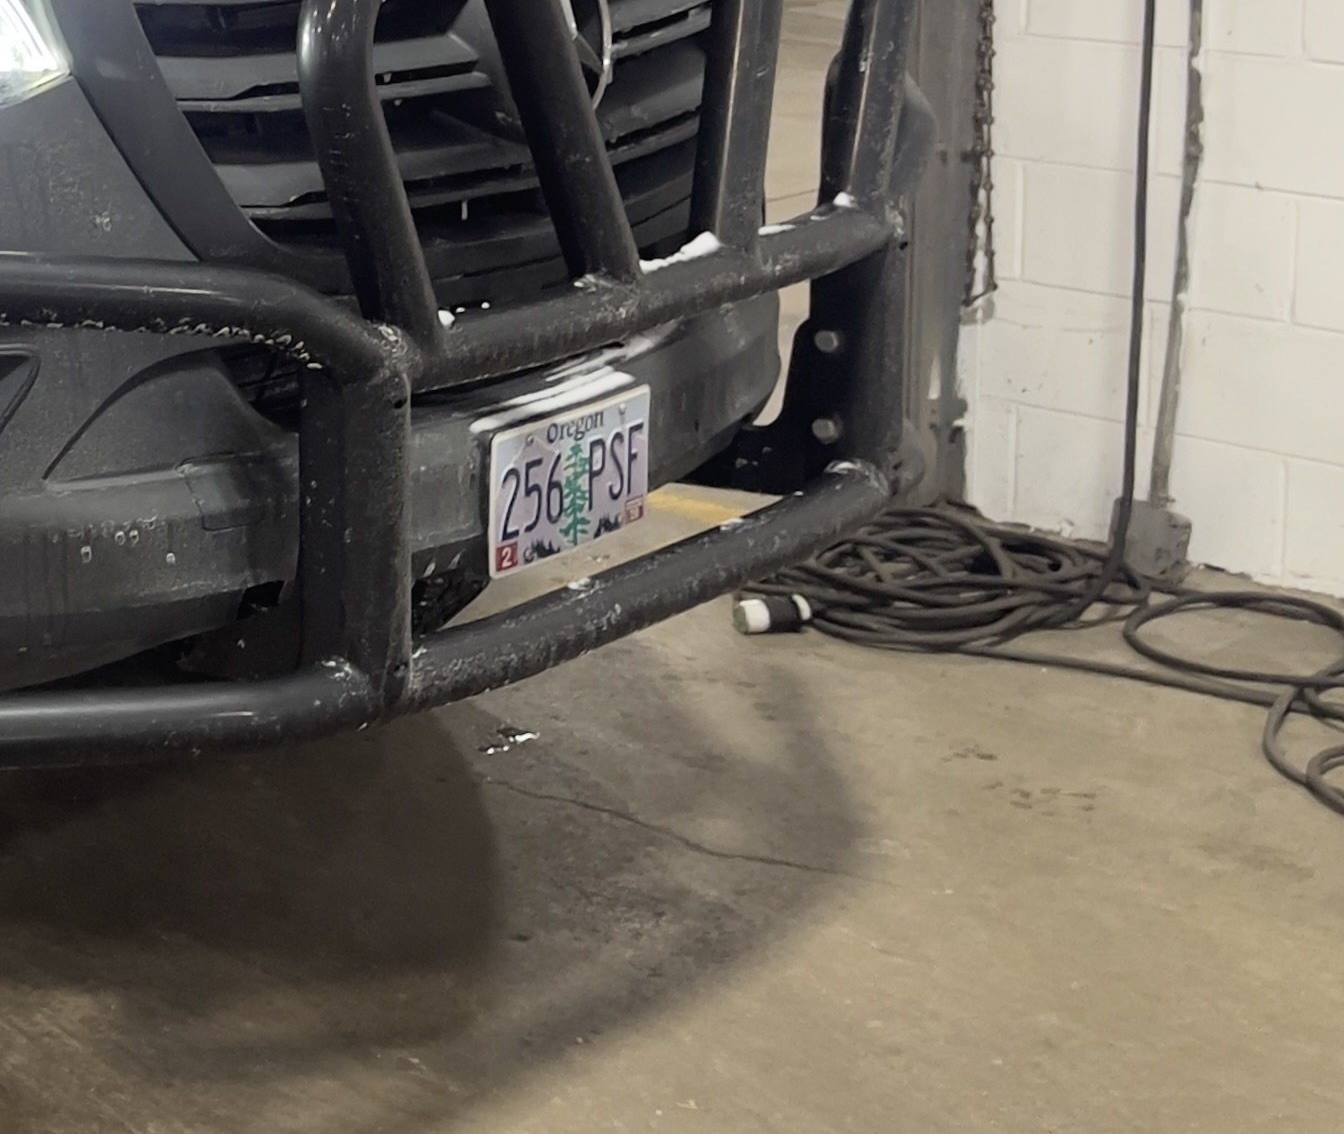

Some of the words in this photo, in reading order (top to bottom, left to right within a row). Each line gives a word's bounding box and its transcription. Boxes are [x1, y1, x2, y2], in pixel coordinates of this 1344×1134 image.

[546, 410, 605, 444] Oregon
[501, 451, 564, 542] 256
[588, 421, 645, 512] PSF
[501, 547, 512, 567] 2
